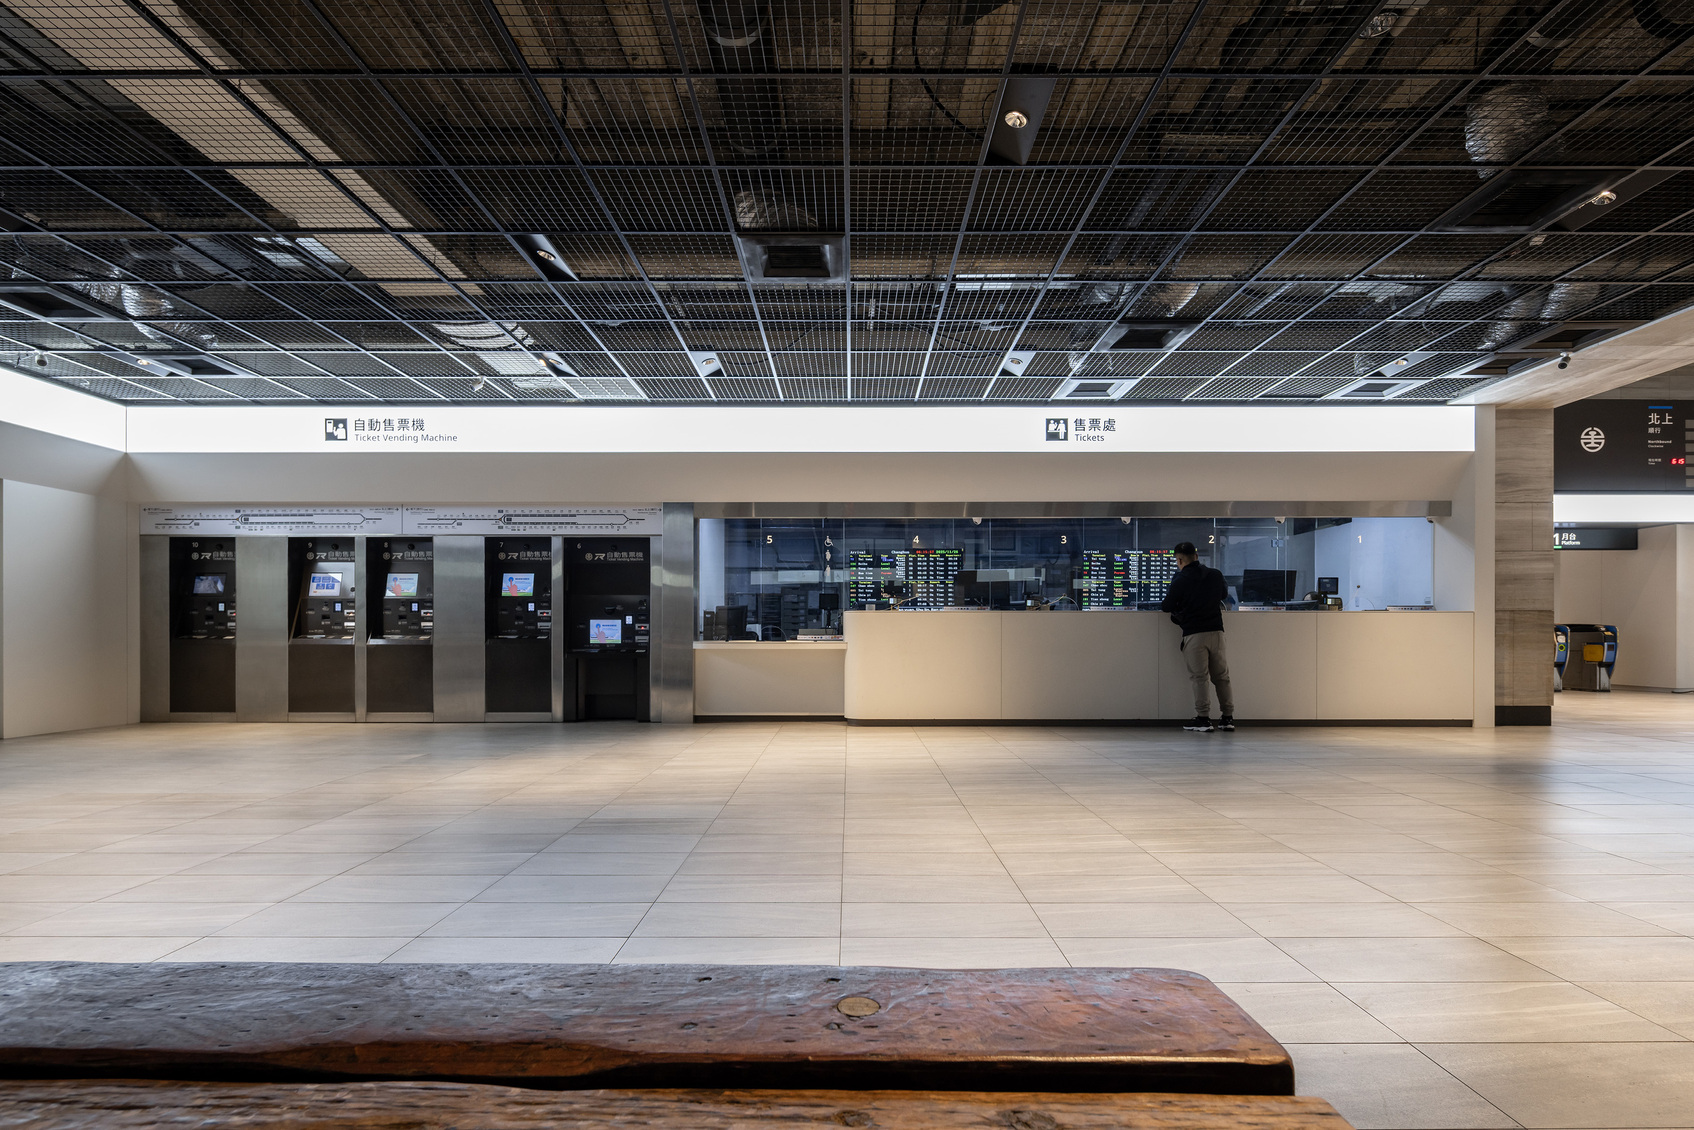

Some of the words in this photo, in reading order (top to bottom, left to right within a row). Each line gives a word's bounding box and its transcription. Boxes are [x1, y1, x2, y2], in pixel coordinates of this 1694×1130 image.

[1648, 413, 1673, 425] 北上
[354, 418, 425, 432] 自動售票機
[1074, 418, 1116, 432] 售票處
[383, 434, 418, 443] Vending
[766, 535, 772, 544] 5
[913, 535, 919, 543] 4
[1061, 535, 1067, 544] 3
[1208, 535, 1214, 544] 2
[1554, 533, 1560, 546] 1
